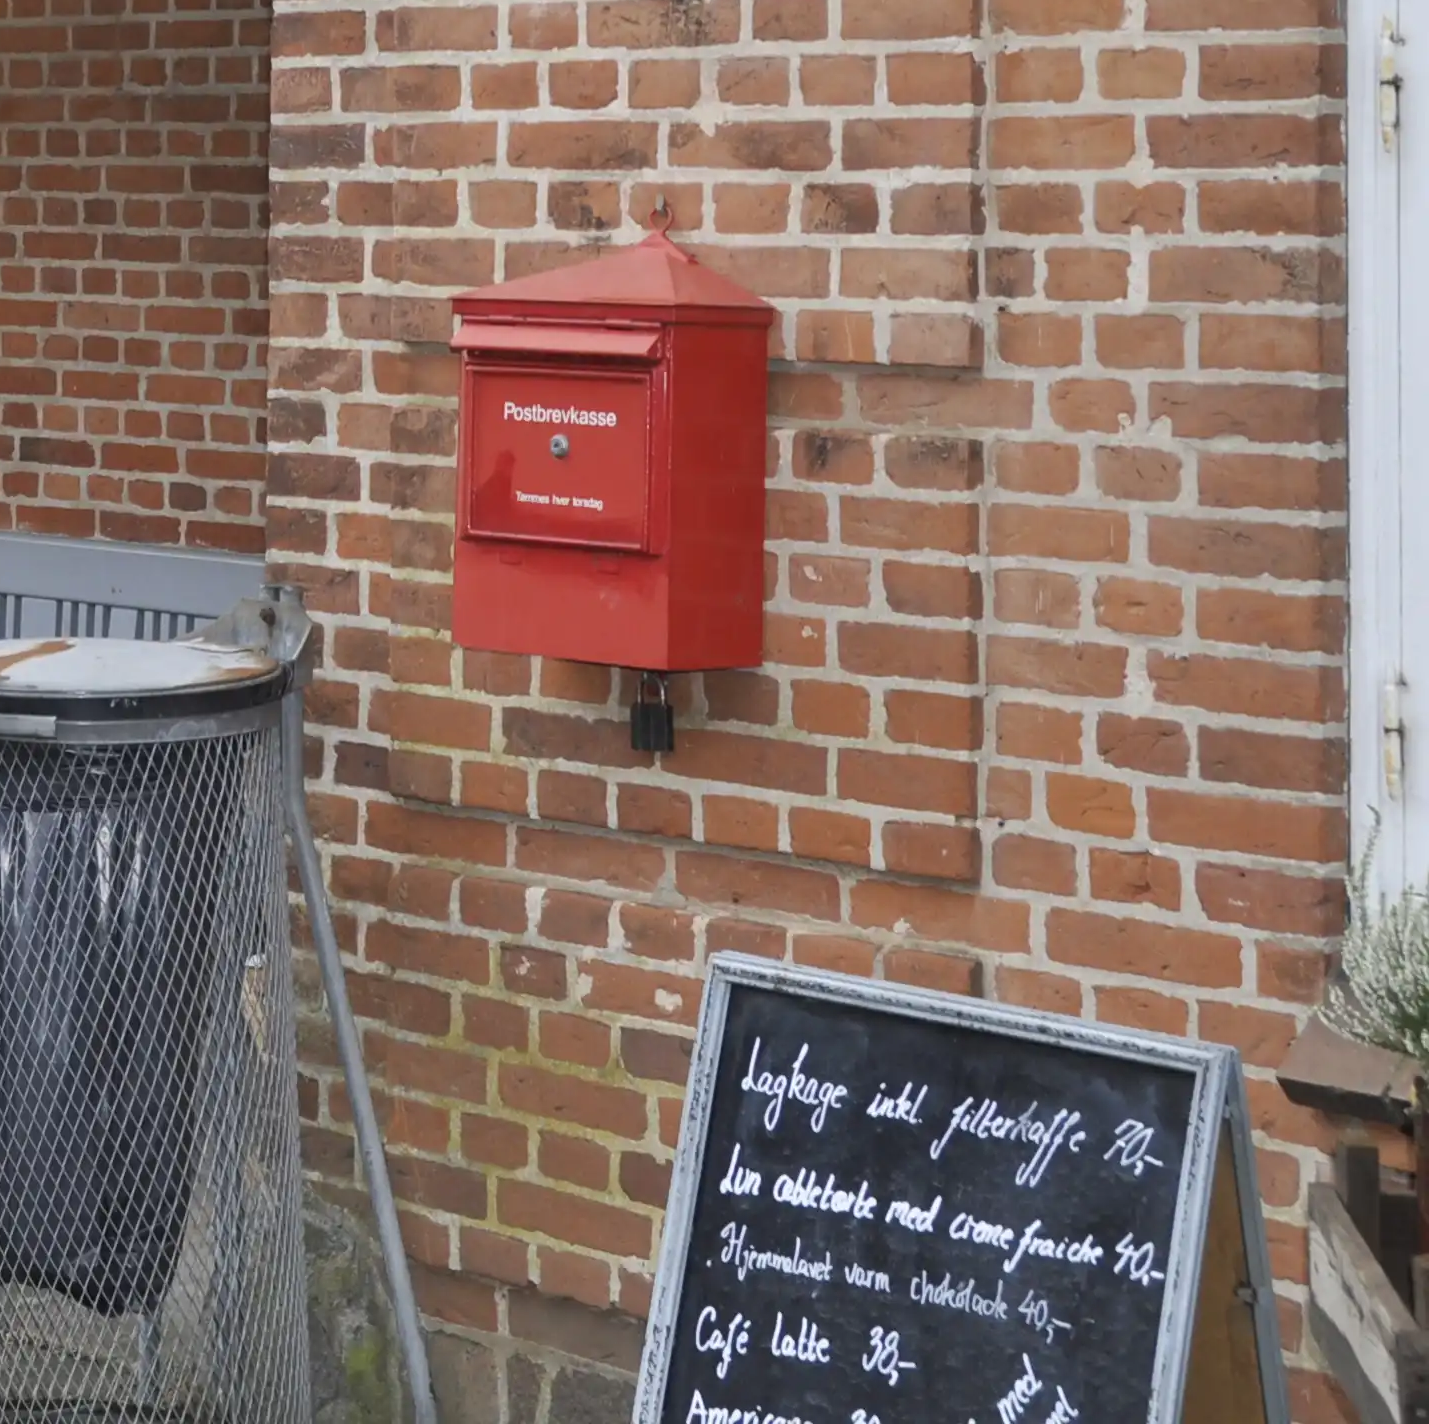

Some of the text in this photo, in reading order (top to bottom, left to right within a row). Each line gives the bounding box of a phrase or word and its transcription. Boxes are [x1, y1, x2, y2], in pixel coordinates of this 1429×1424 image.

[503, 401, 617, 427] Postbrevkasse
[741, 1036, 848, 1133] Lagkage
[929, 1096, 1086, 1187] filterkaffe
[719, 1142, 762, 1196] Lun
[885, 1193, 942, 1233] med
[844, 1262, 891, 1293] varm
[695, 1305, 752, 1380] Café
[771, 1311, 831, 1364] latte
[996, 1352, 1043, 1424] med
